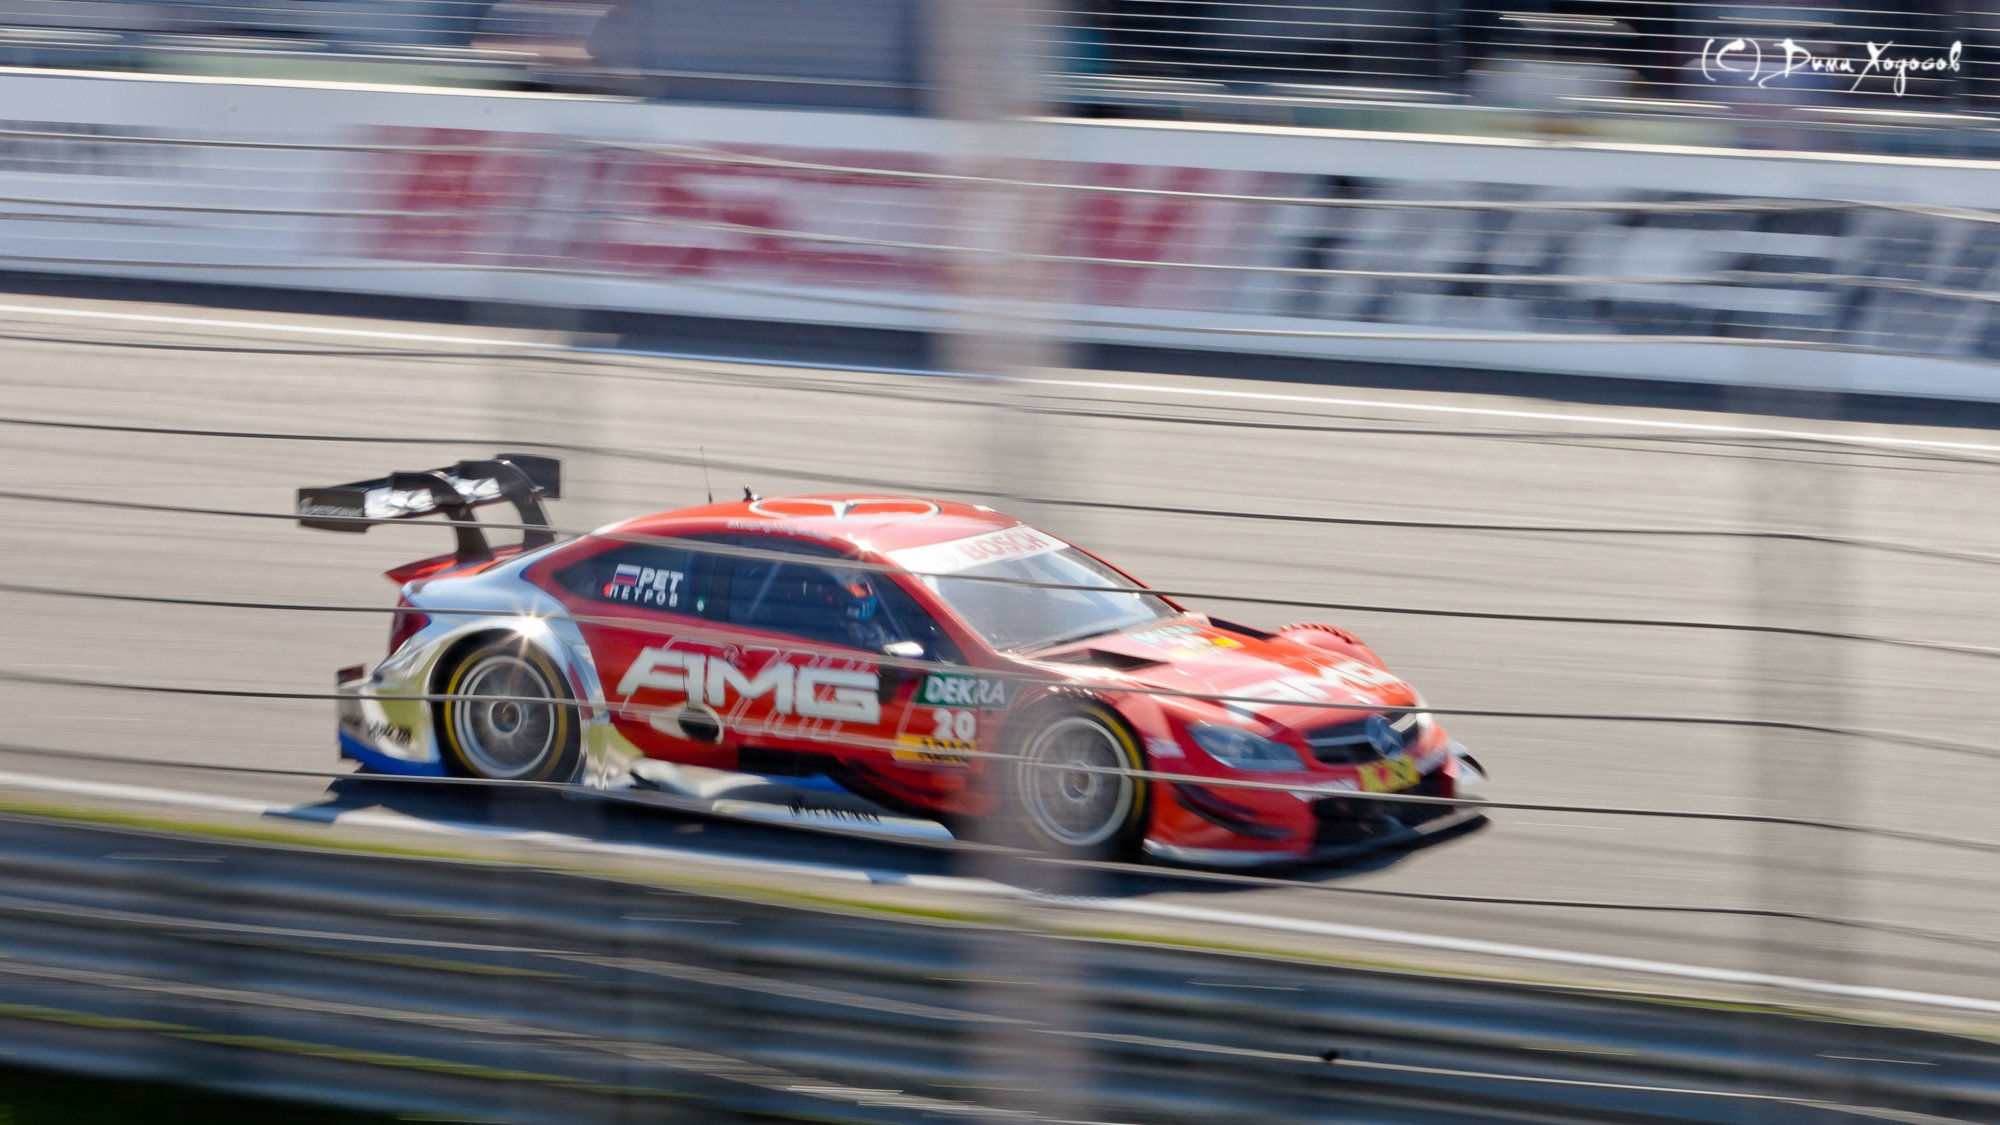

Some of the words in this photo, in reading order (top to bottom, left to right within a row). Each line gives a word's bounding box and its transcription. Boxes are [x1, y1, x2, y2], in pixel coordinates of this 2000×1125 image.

[957, 529, 1051, 561] BOSCH
[638, 566, 684, 593] PET
[608, 584, 678, 608] ПЕТРОВ
[616, 646, 880, 725] AMG
[924, 675, 1005, 705] DEKRA
[932, 708, 976, 742] 20
